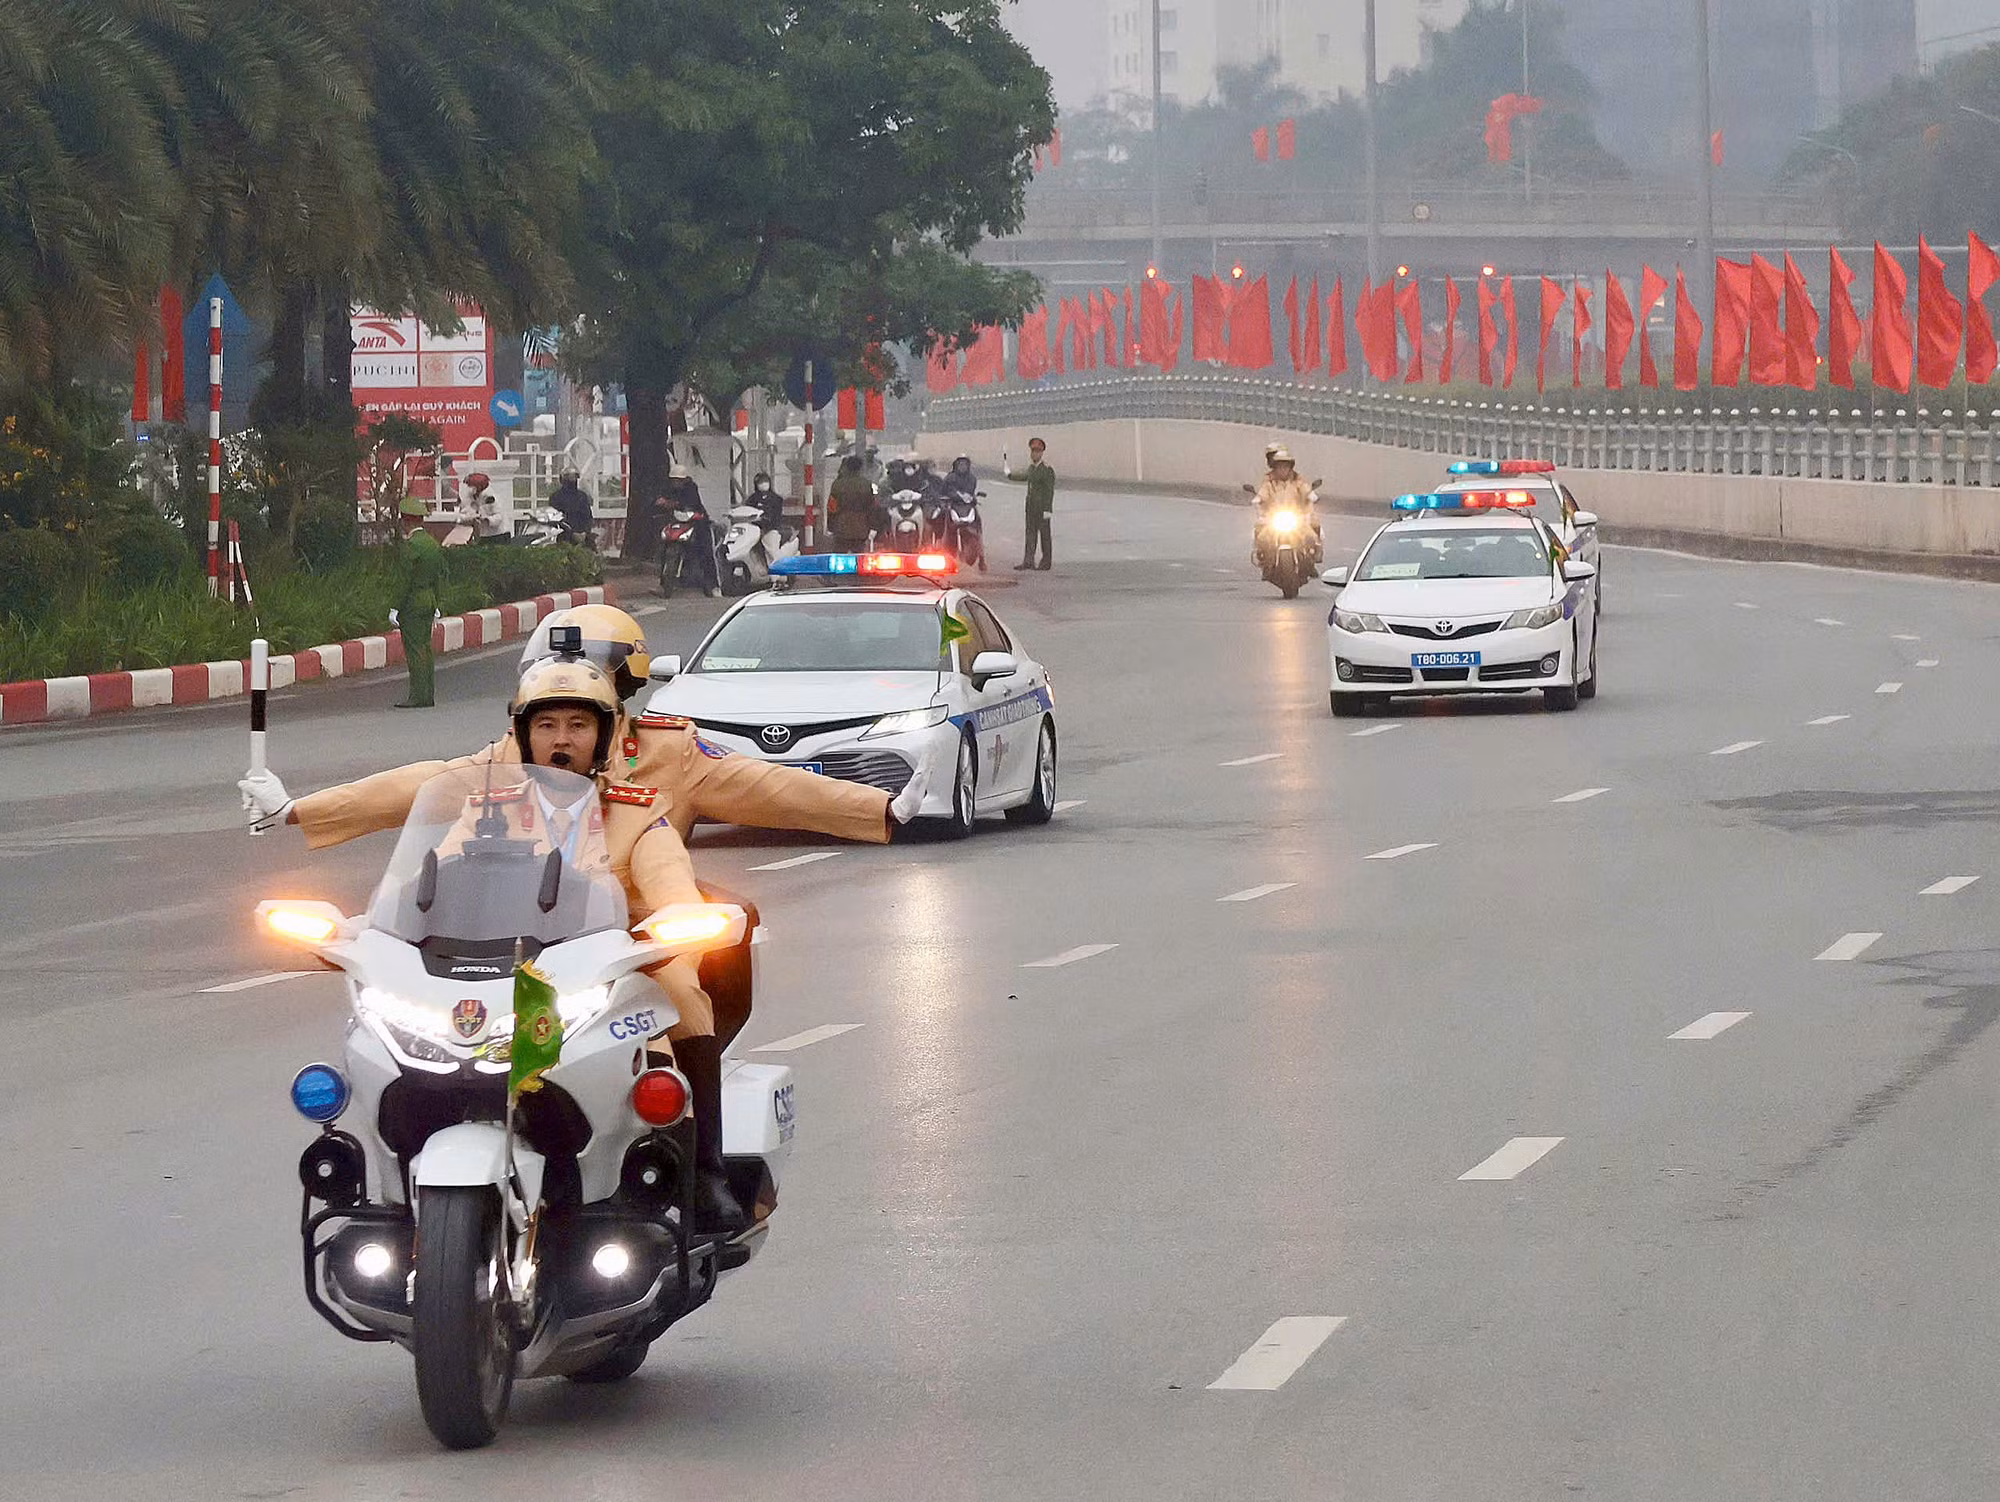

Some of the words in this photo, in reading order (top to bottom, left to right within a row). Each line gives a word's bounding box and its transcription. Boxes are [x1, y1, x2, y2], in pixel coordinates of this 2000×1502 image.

[358, 336, 387, 349] ANTA
[429, 415, 466, 424] AGAIN
[451, 965, 501, 974] HONDA
[609, 1009, 658, 1040] CSGT
